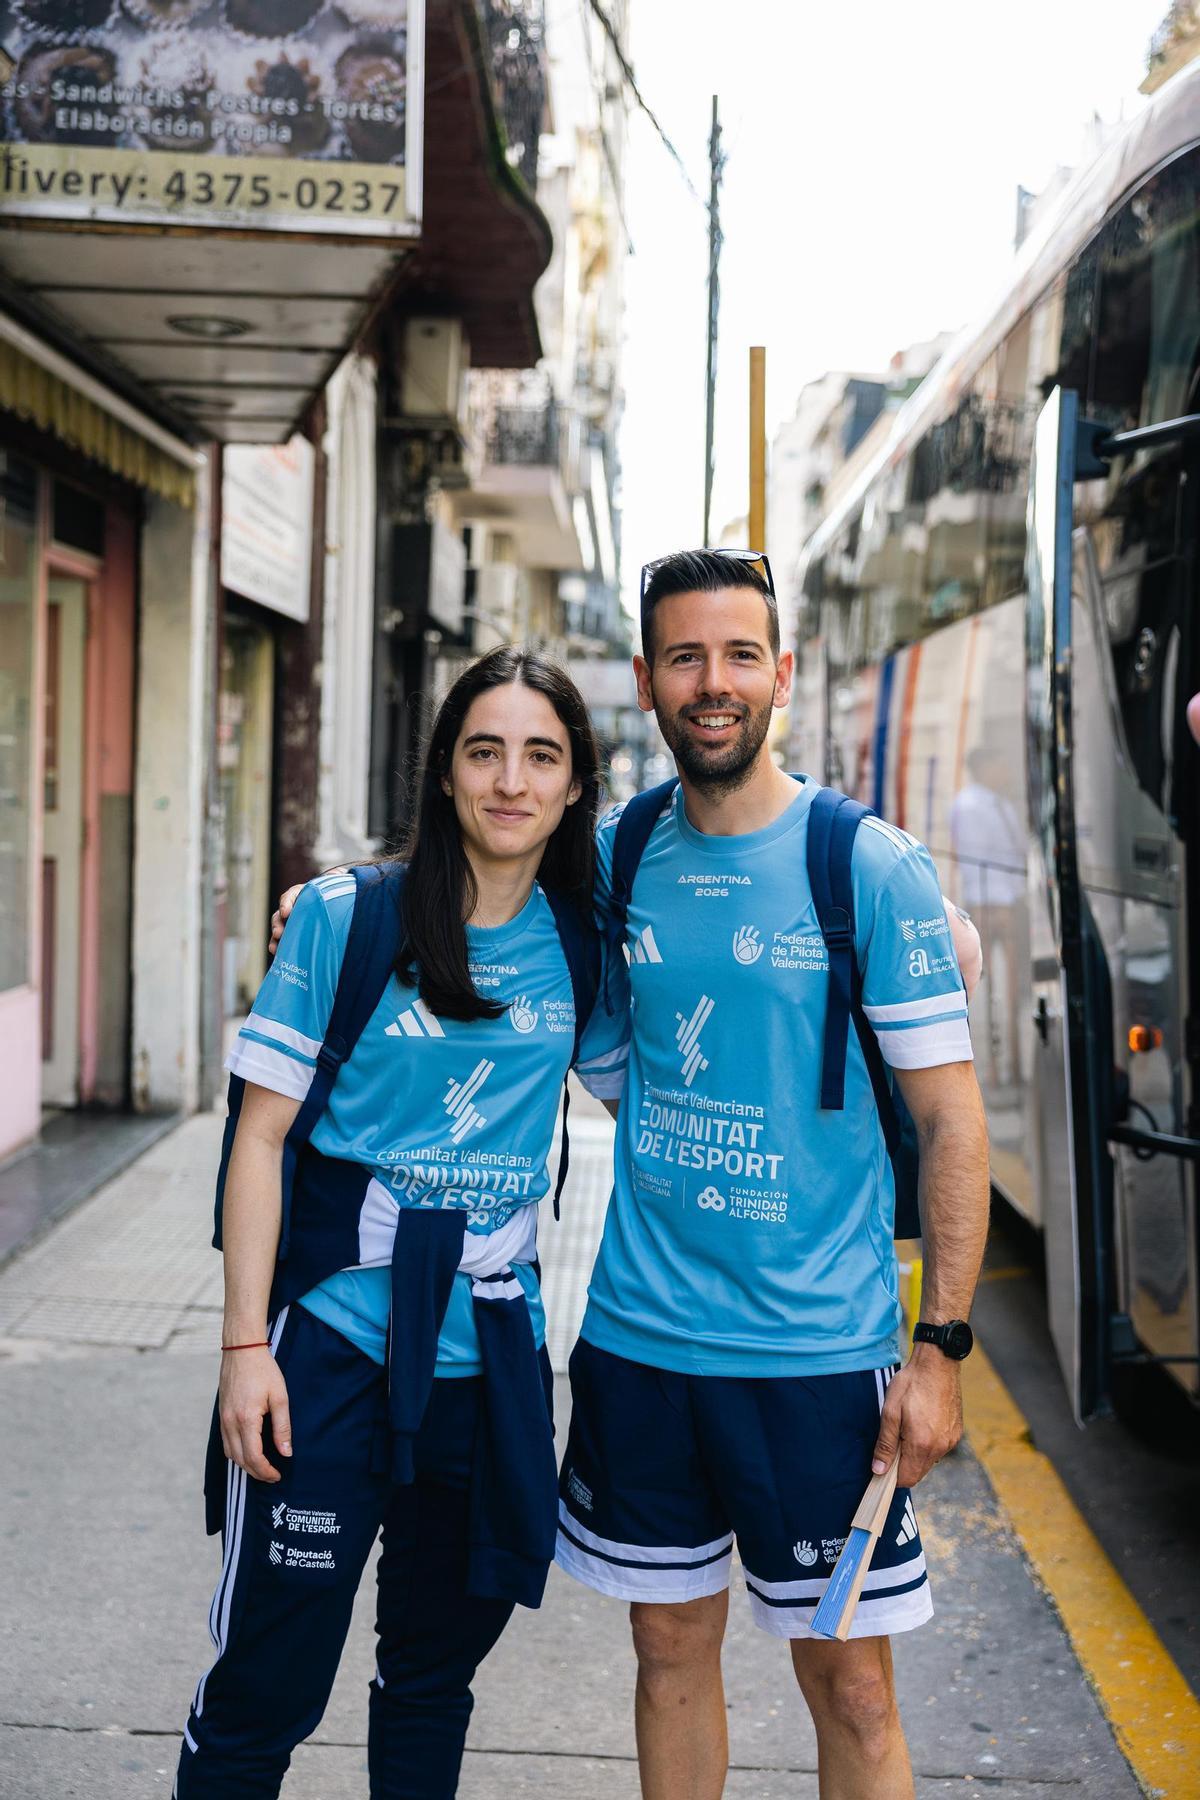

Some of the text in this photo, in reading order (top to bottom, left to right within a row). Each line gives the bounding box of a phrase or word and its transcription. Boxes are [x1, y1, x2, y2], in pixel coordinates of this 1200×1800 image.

[51, 79, 185, 109] Sandwichs
[206, 90, 300, 116] Postres
[321, 100, 397, 122] Tortas
[55, 106, 293, 144] Elaboración Propia
[164, 168, 400, 214] 4375-0237
[677, 874, 752, 885] ARGENTINA
[694, 887, 729, 897] 2026
[771, 944, 824, 959] de Pilota
[468, 963, 519, 975] GENTINA
[545, 1011, 558, 1021] de
[689, 1091, 764, 1118] Valenciana
[460, 1150, 532, 1168] Valenciana
[636, 1130, 784, 1180] DE L'ESPORT
[730, 1186, 789, 1200] FUNDACIÓN
[729, 1195, 788, 1212] TRINIDAD
[728, 1207, 787, 1223] ALFONSO
[286, 1507, 337, 1518] Comunitat Valenciana
[285, 1513, 336, 1526] COMUNITAT
[288, 1522, 342, 1534] DE L'ESPORT
[286, 1548, 333, 1560] Diputació
[823, 1547, 835, 1556] de
[285, 1557, 336, 1569] de Castelló
